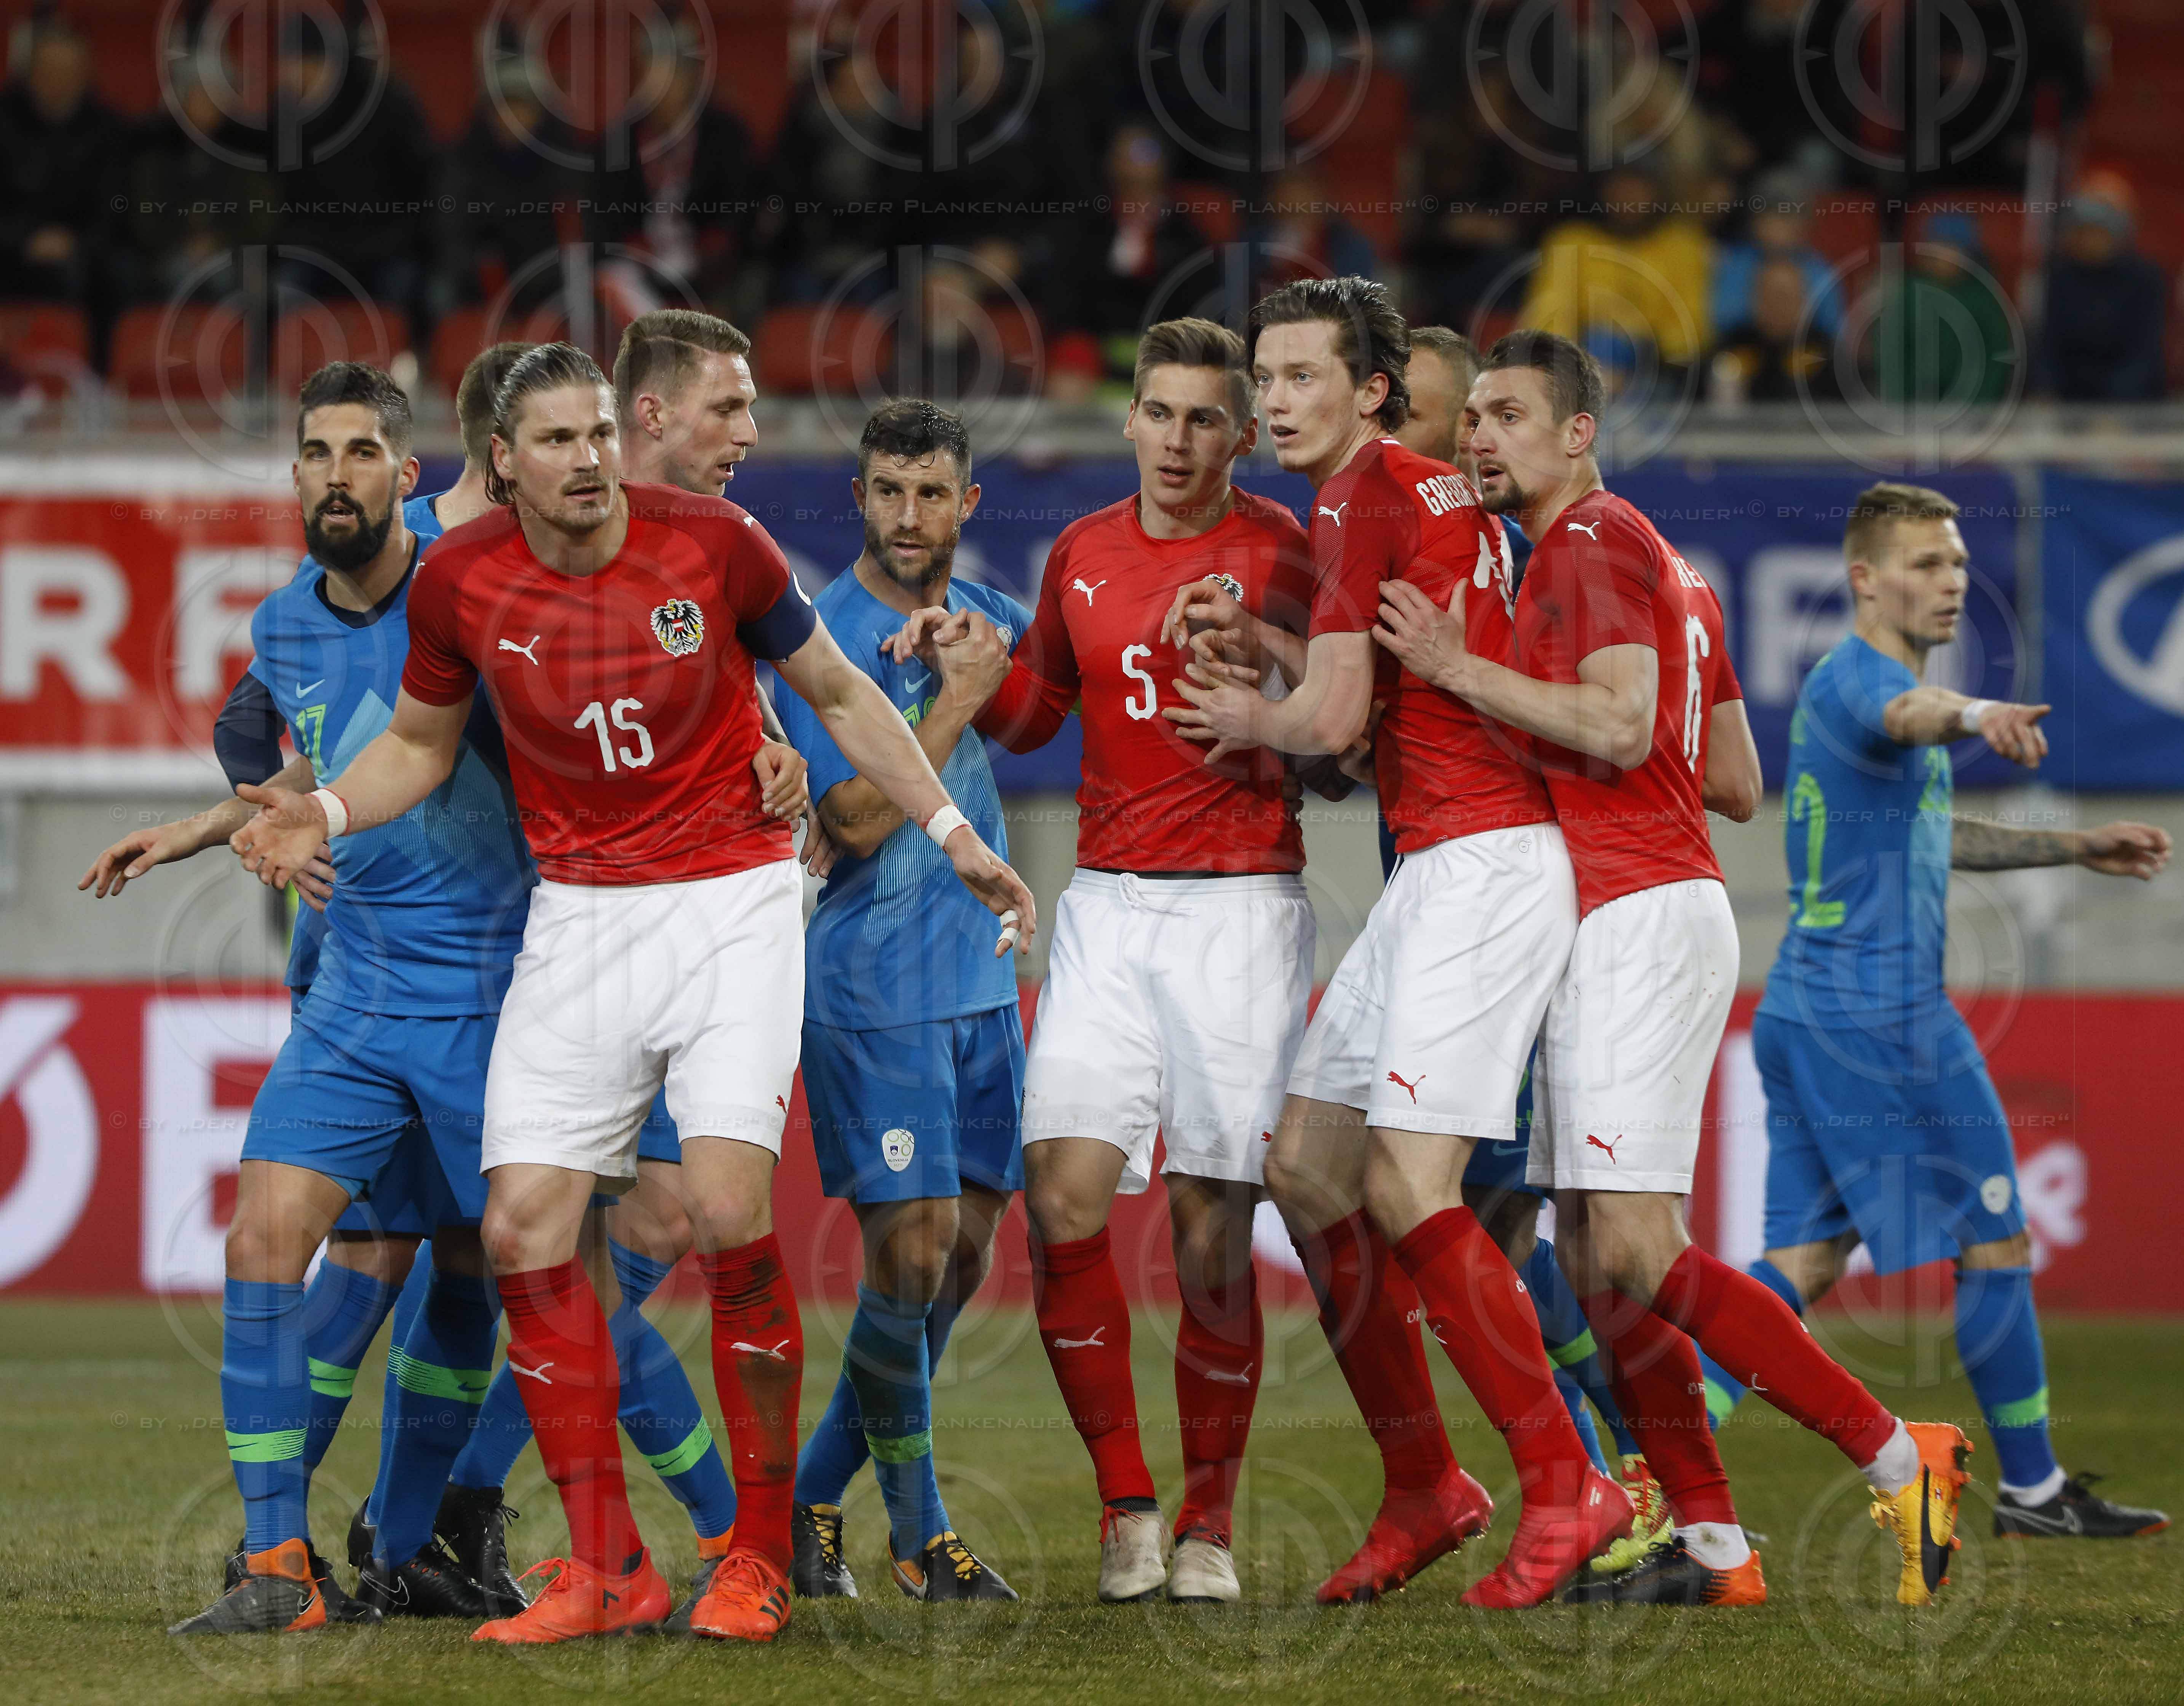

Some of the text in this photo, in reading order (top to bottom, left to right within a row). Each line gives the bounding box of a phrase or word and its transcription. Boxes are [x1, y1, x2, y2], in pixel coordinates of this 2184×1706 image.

[1122, 644, 1157, 720] 5
[1685, 613, 1710, 773] 6
[574, 697, 655, 772] 15
